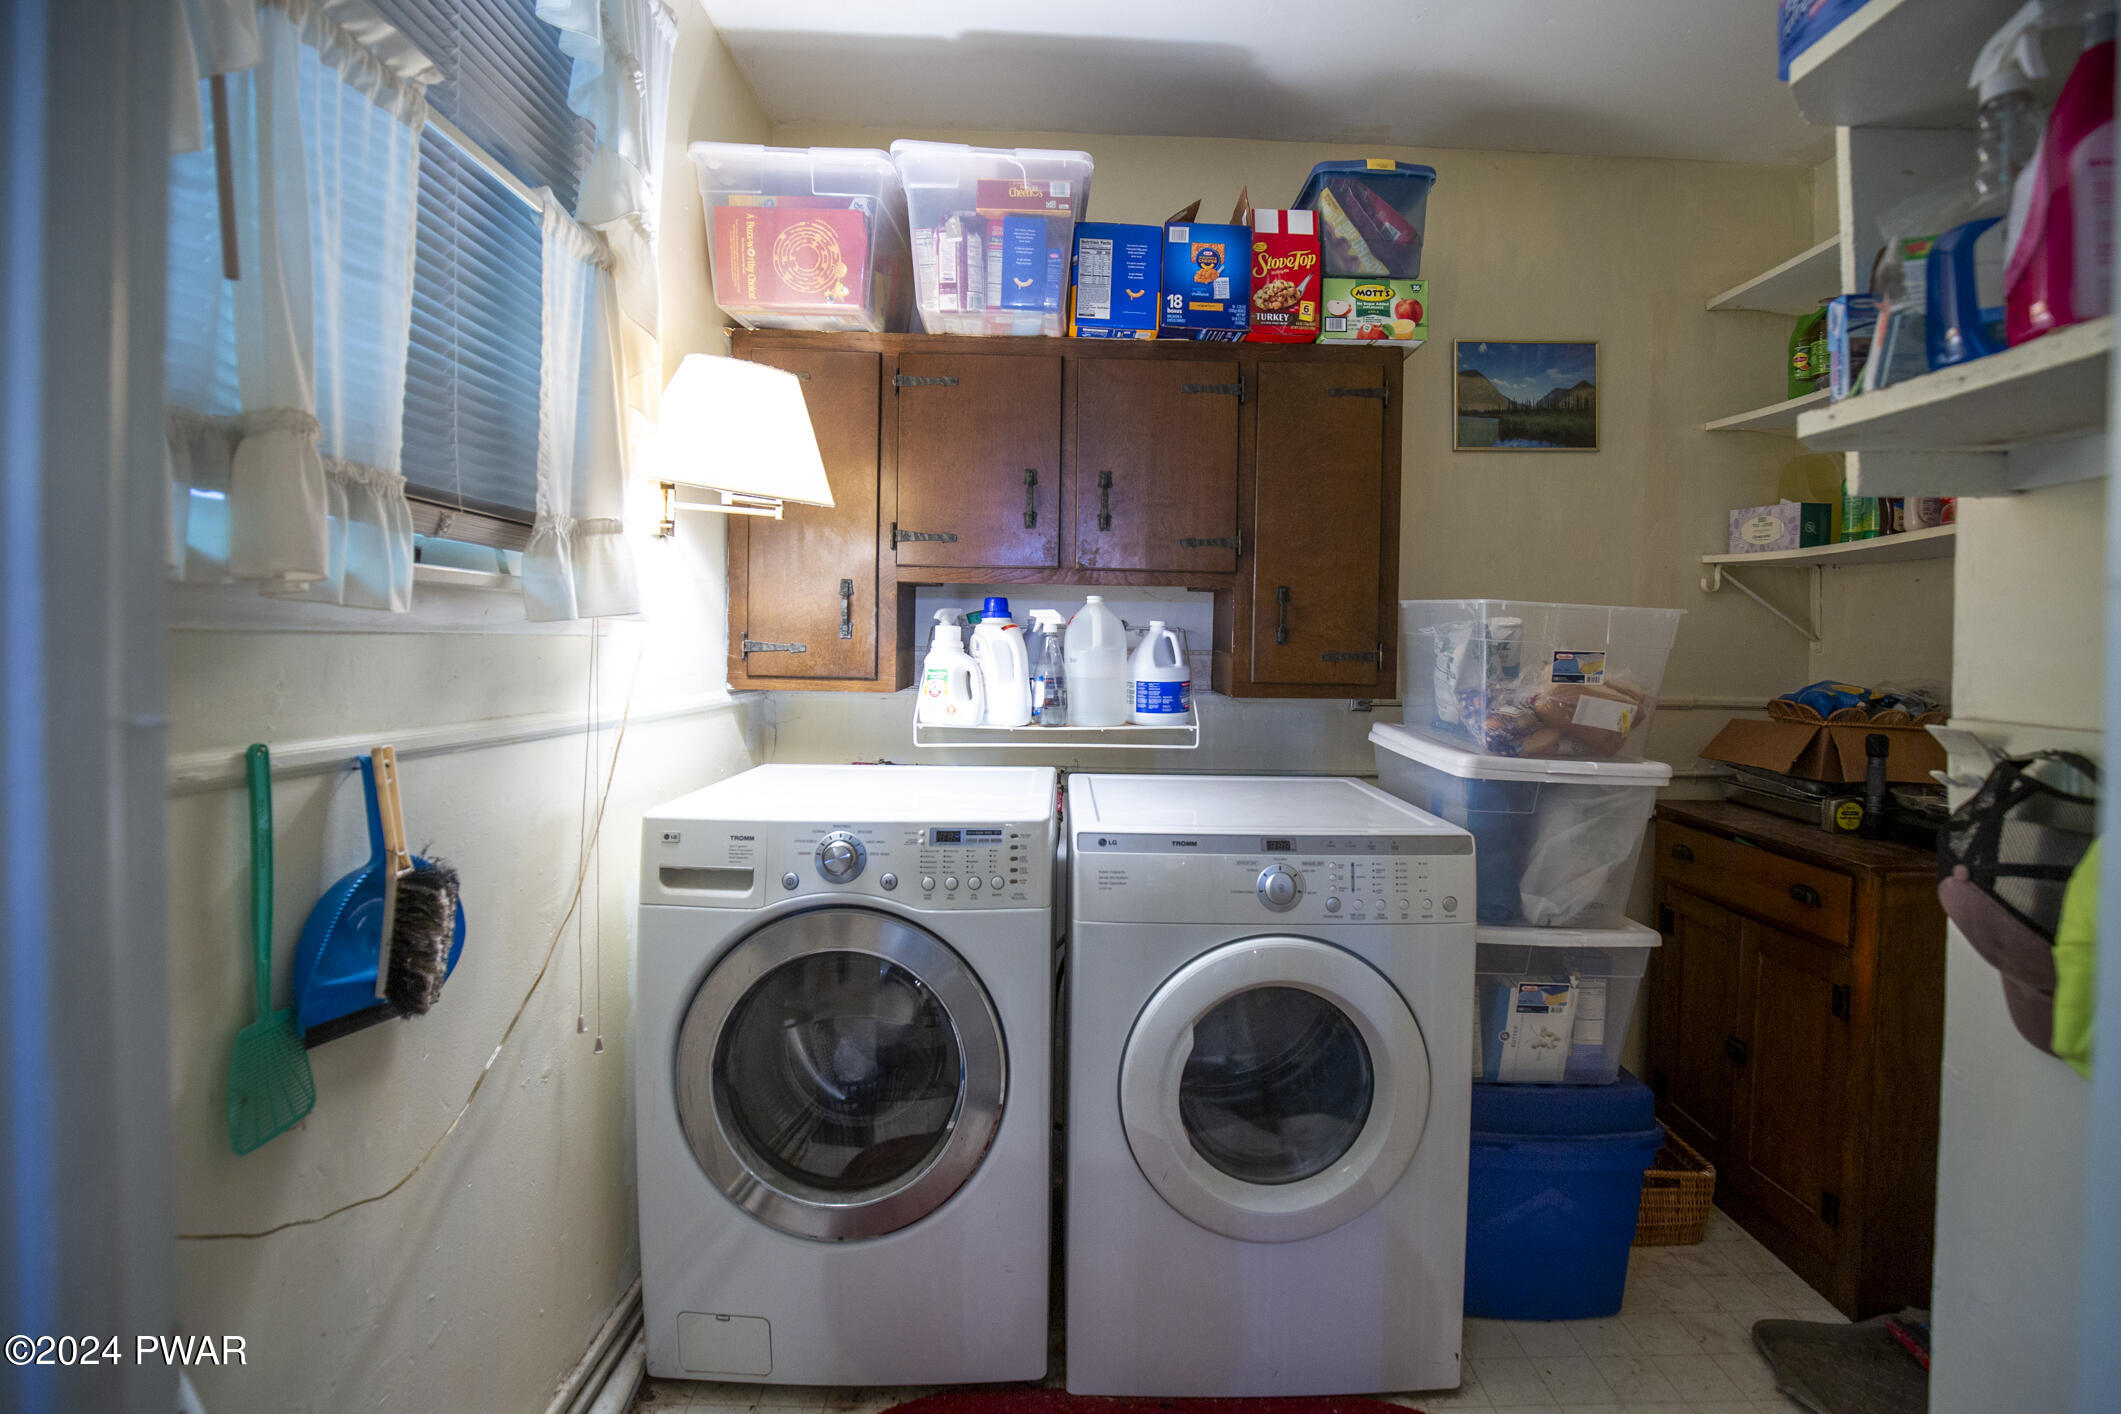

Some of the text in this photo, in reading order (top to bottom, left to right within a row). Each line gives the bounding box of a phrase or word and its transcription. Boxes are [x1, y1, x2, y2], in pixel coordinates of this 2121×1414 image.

[1252, 250, 1317, 278] Stove Top
[1355, 289, 1391, 298] MOTT'S
[1167, 294, 1183, 309] 18
[1303, 304, 1311, 313] 6
[1256, 312, 1289, 322] TURKEY
